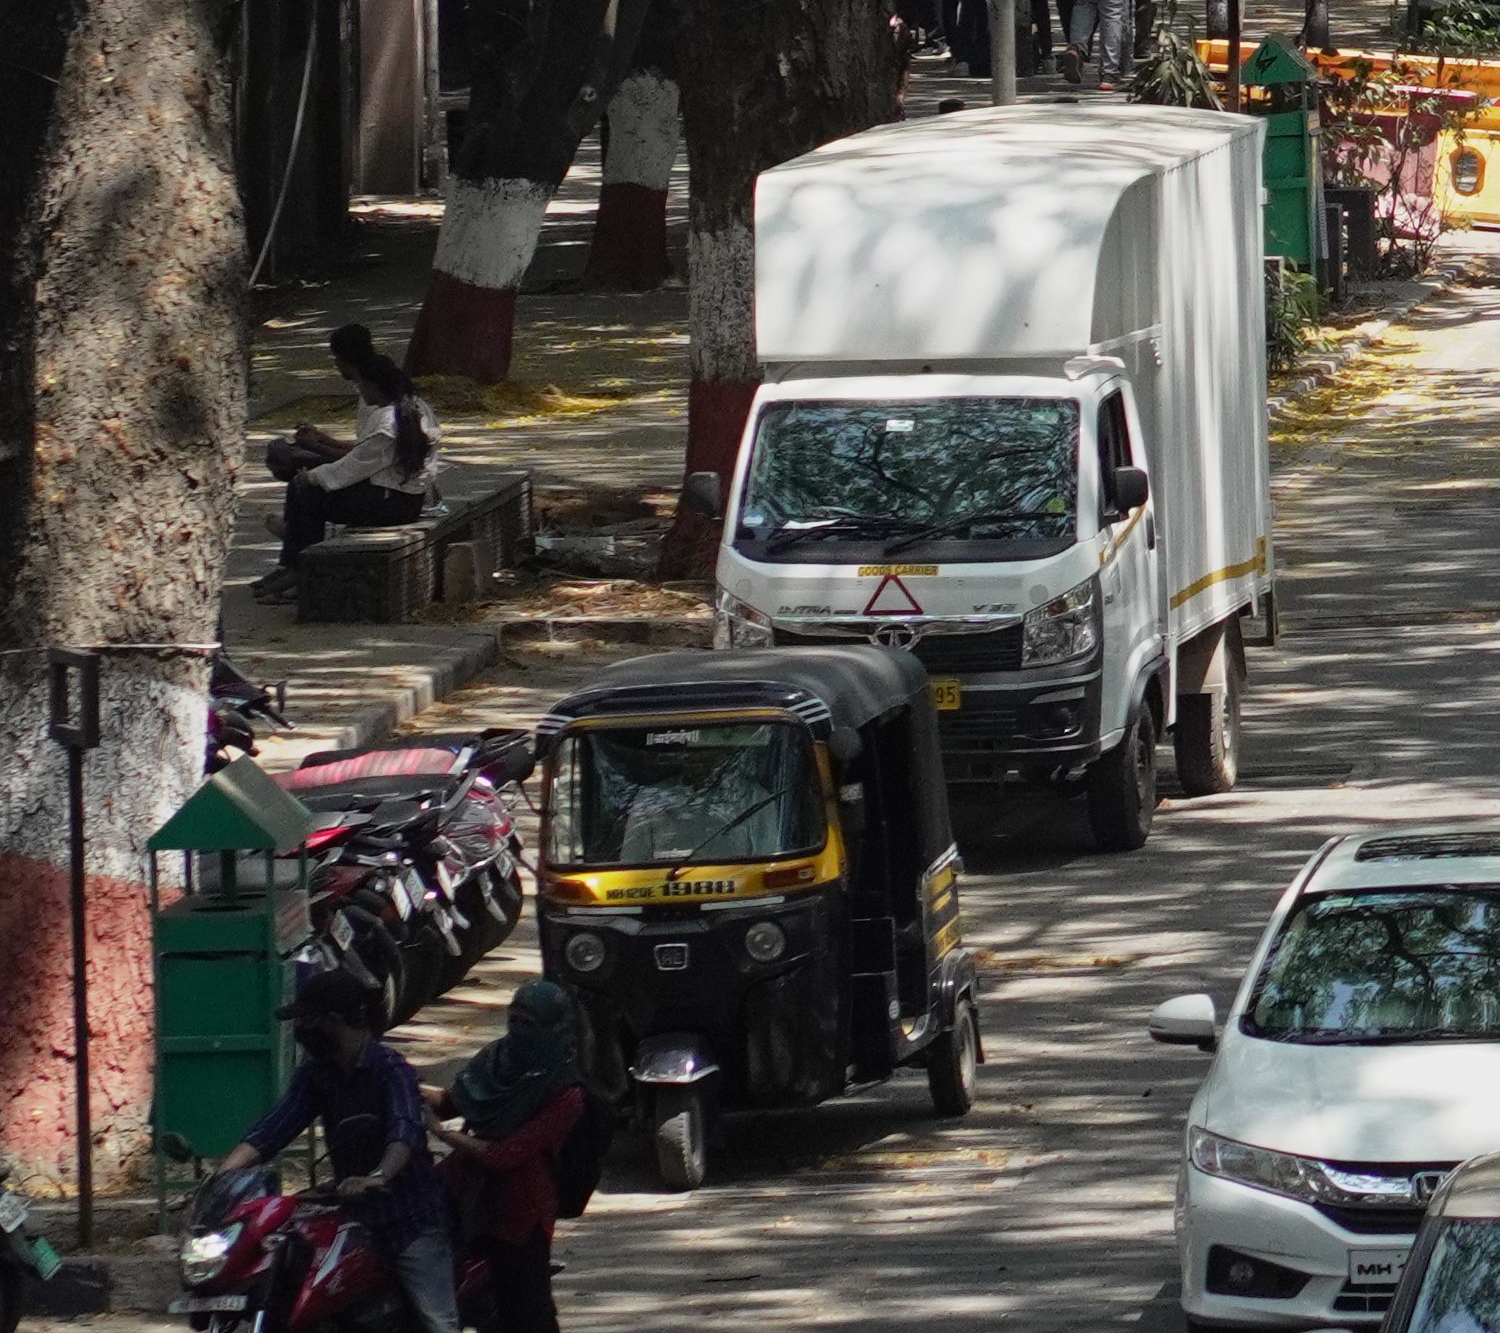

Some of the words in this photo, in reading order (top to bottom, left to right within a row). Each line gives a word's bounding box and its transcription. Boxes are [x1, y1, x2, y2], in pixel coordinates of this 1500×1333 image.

[858, 566, 892, 577] GOODS
[895, 565, 939, 576] CARRIER
[663, 880, 735, 896] 1988
